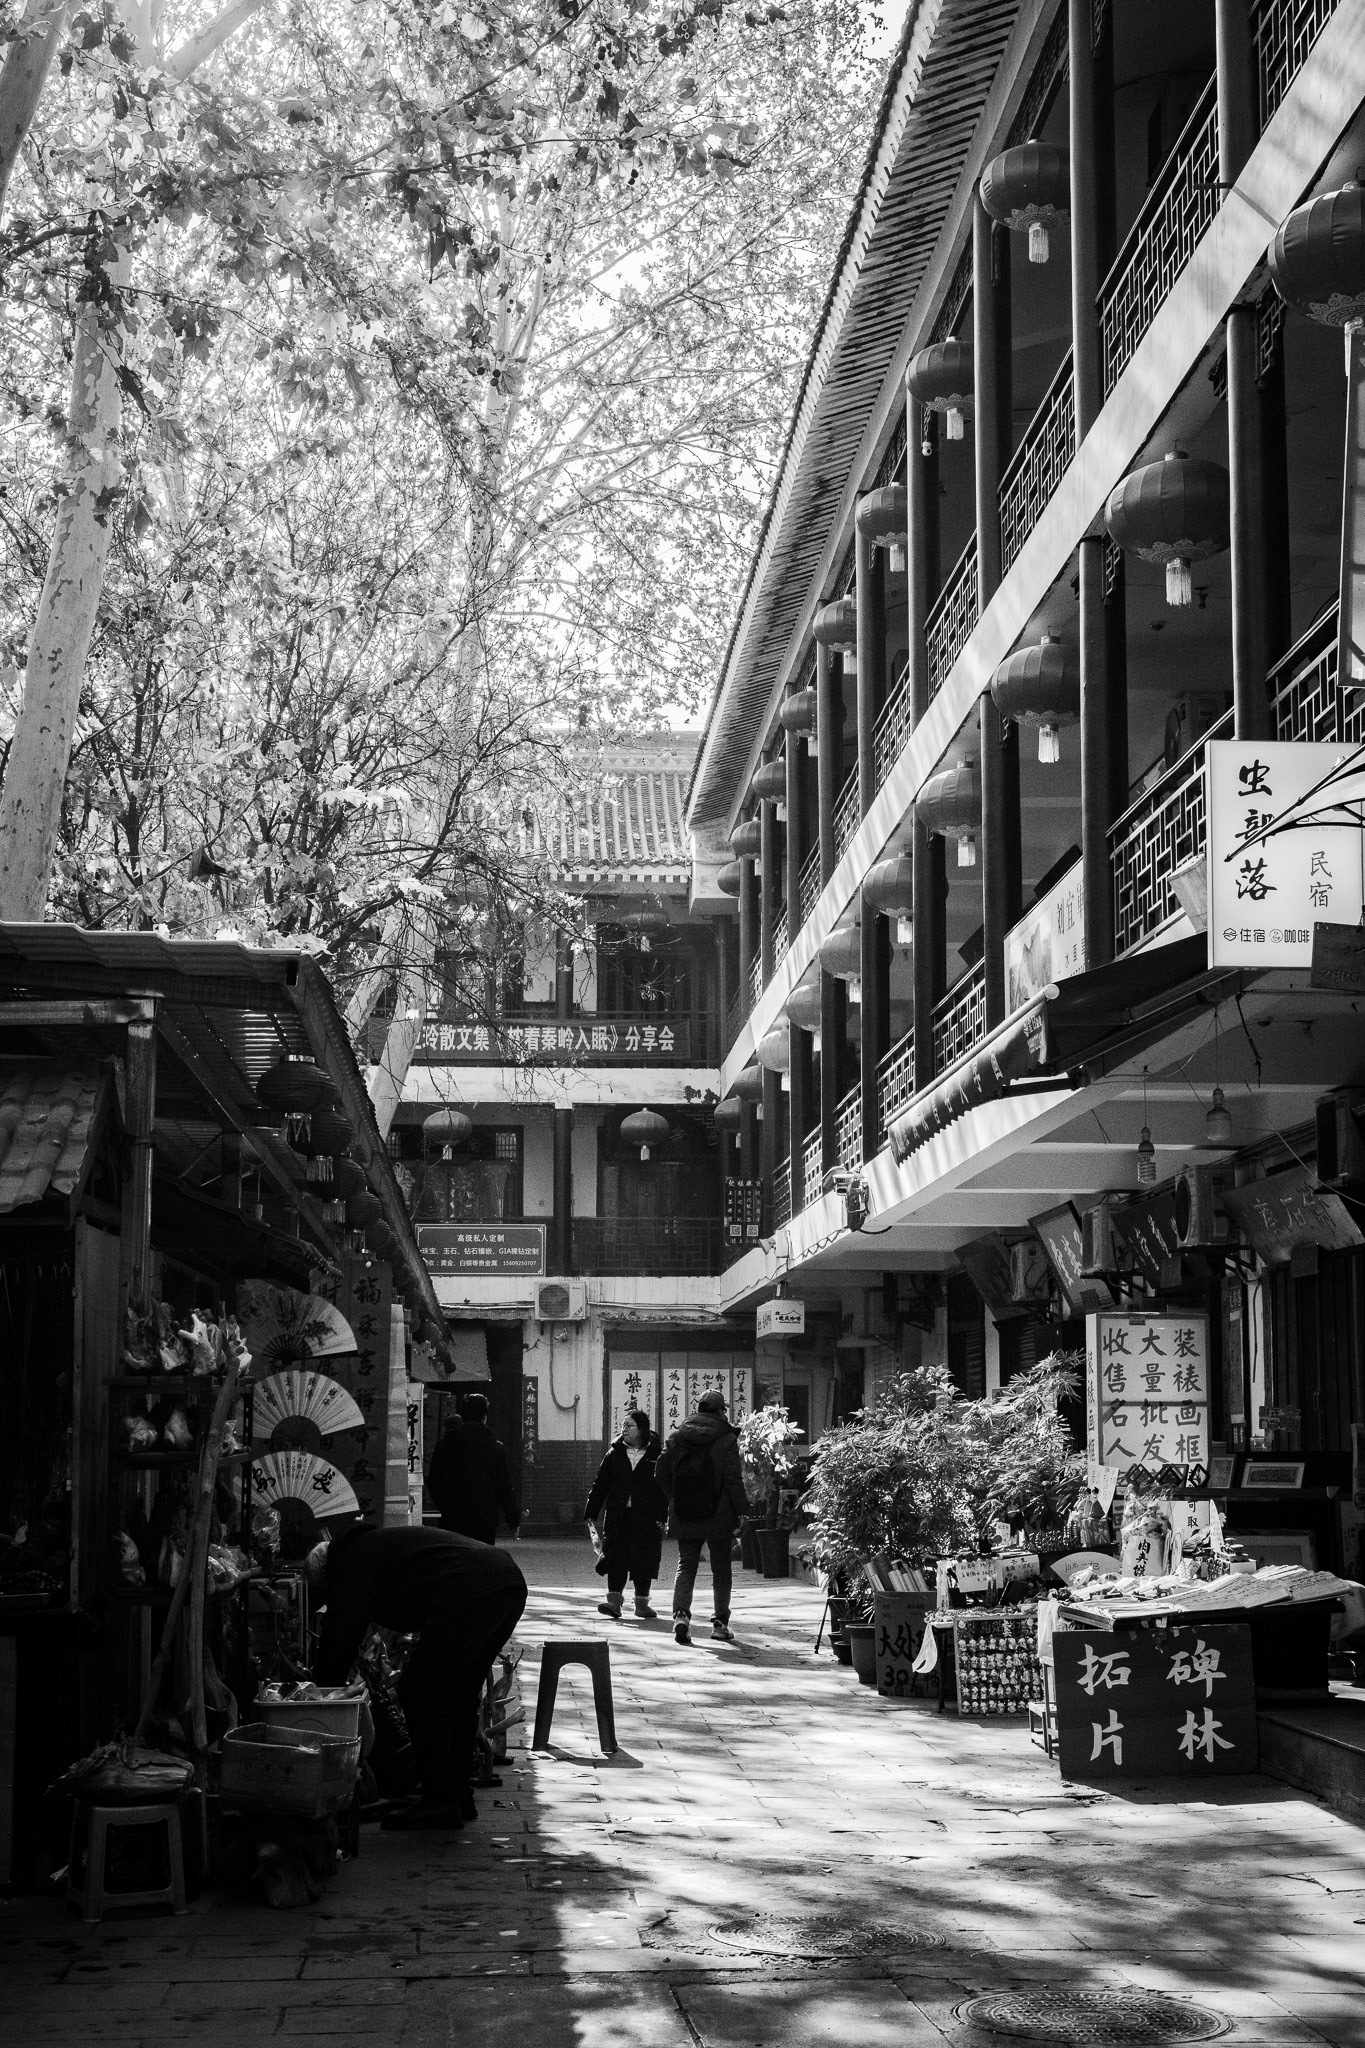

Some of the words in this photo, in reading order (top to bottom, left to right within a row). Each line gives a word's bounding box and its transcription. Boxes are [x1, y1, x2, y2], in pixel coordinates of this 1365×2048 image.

[1235, 759, 1277, 900] 虫部落
[1309, 850, 1333, 908] 民宿
[1240, 928, 1265, 943] 住宿
[1284, 929, 1310, 943] 咖啡
[457, 1234, 505, 1243] 高级私人定制
[1173, 1328, 1203, 1464] 装裱画框
[1077, 1643, 1131, 1766] 拓片
[1165, 1639, 1235, 1763] 碑林
